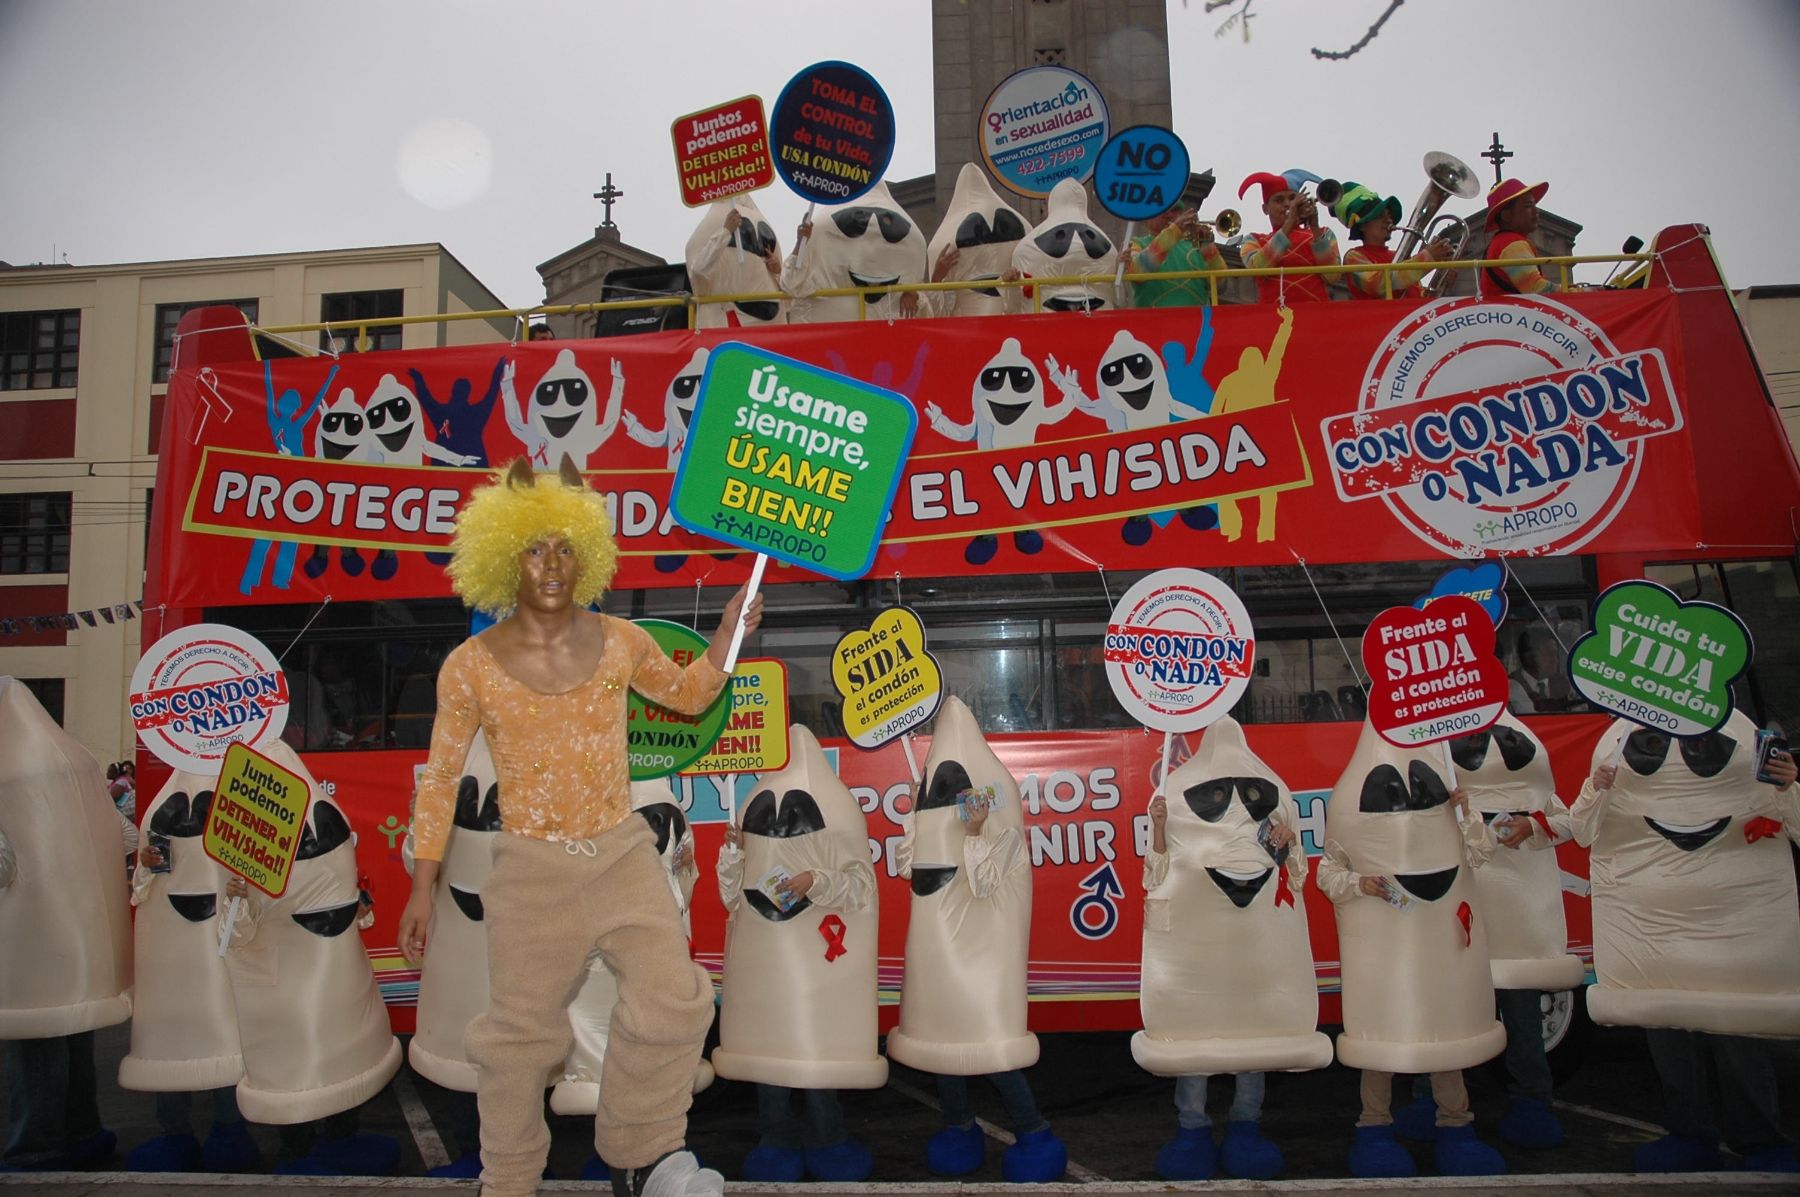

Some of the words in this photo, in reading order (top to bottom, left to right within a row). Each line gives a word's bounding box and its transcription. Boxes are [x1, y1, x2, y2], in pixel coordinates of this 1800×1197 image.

[811, 78, 856, 107] TOMA
[859, 96, 878, 115] EL
[686, 120, 758, 155] podemos
[692, 109, 742, 137] Juntos
[801, 102, 875, 140] CONTROL
[995, 135, 1009, 146] en
[1009, 104, 1094, 142] sexualidad
[683, 143, 747, 173] DETENER
[751, 138, 763, 154] el
[781, 144, 811, 167] USA
[812, 155, 871, 185] CONDÓN
[793, 127, 812, 145] de
[816, 134, 832, 151] tu
[835, 139, 873, 166] Vida,
[995, 127, 1100, 166] www.nosedesexo.com
[1016, 145, 1085, 176] 422-7599
[1116, 140, 1172, 171] NO
[685, 156, 766, 191] VIH/Sida!!
[714, 177, 756, 199] APROPO
[807, 174, 850, 197] APROPO
[1108, 181, 1165, 206] SIDA
[1390, 333, 1435, 400] TENEMOS
[1434, 312, 1513, 338] DERECHO
[1517, 316, 1528, 328] A
[1532, 320, 1579, 359] DECIR:
[748, 364, 869, 434] Úsame
[1335, 425, 1412, 470] CON
[1414, 353, 1650, 461] CONDÓN
[735, 402, 869, 471] siempre,
[212, 470, 460, 535] PROTEGE
[910, 469, 979, 521] EL
[992, 424, 1267, 509] VIH/SIDA
[726, 433, 853, 503] ÚSAME
[1454, 423, 1626, 505] NADA
[720, 477, 834, 538] BIEN!!
[1503, 501, 1577, 534] APROPO
[741, 521, 827, 563] APROPO
[1137, 597, 1165, 624] TENEMOS
[1165, 593, 1200, 605] DERECHO
[841, 628, 888, 664] Frente
[891, 619, 902, 634] al
[1106, 635, 1137, 650] CON
[1380, 617, 1447, 645] Frente
[1451, 612, 1468, 627] al
[1617, 604, 1692, 644] Cuida
[1697, 633, 1727, 657] tu
[161, 656, 185, 687] TENEMOS
[183, 647, 221, 660] DERECHO
[847, 637, 914, 694] SIDA
[1150, 659, 1223, 686] NADA
[1384, 633, 1477, 681] SIDA
[1609, 624, 1714, 693] VIDA
[856, 698, 866, 711] el
[868, 667, 920, 703] condón
[860, 714, 871, 725] es
[873, 682, 925, 720] protección
[1159, 692, 1194, 704] APROPO
[1391, 686, 1405, 702] el
[1408, 668, 1481, 698] condón
[1394, 707, 1409, 719] es
[1413, 688, 1485, 717] protección
[1578, 657, 1626, 682] exige
[1630, 674, 1721, 719] condón
[132, 699, 168, 718] CON
[189, 701, 266, 734] NADA
[886, 705, 925, 736] APROPO
[1429, 713, 1481, 737] APROPO
[1617, 699, 1679, 730] APROPO
[627, 730, 700, 749] ONDÓN
[242, 759, 288, 799] Juntos
[713, 756, 764, 770] APROPO
[229, 777, 295, 825] podemos
[217, 794, 278, 844] DETENER
[278, 835, 292, 853] el
[213, 816, 286, 876] VIH/Sida!!
[231, 857, 267, 885] APROPO
